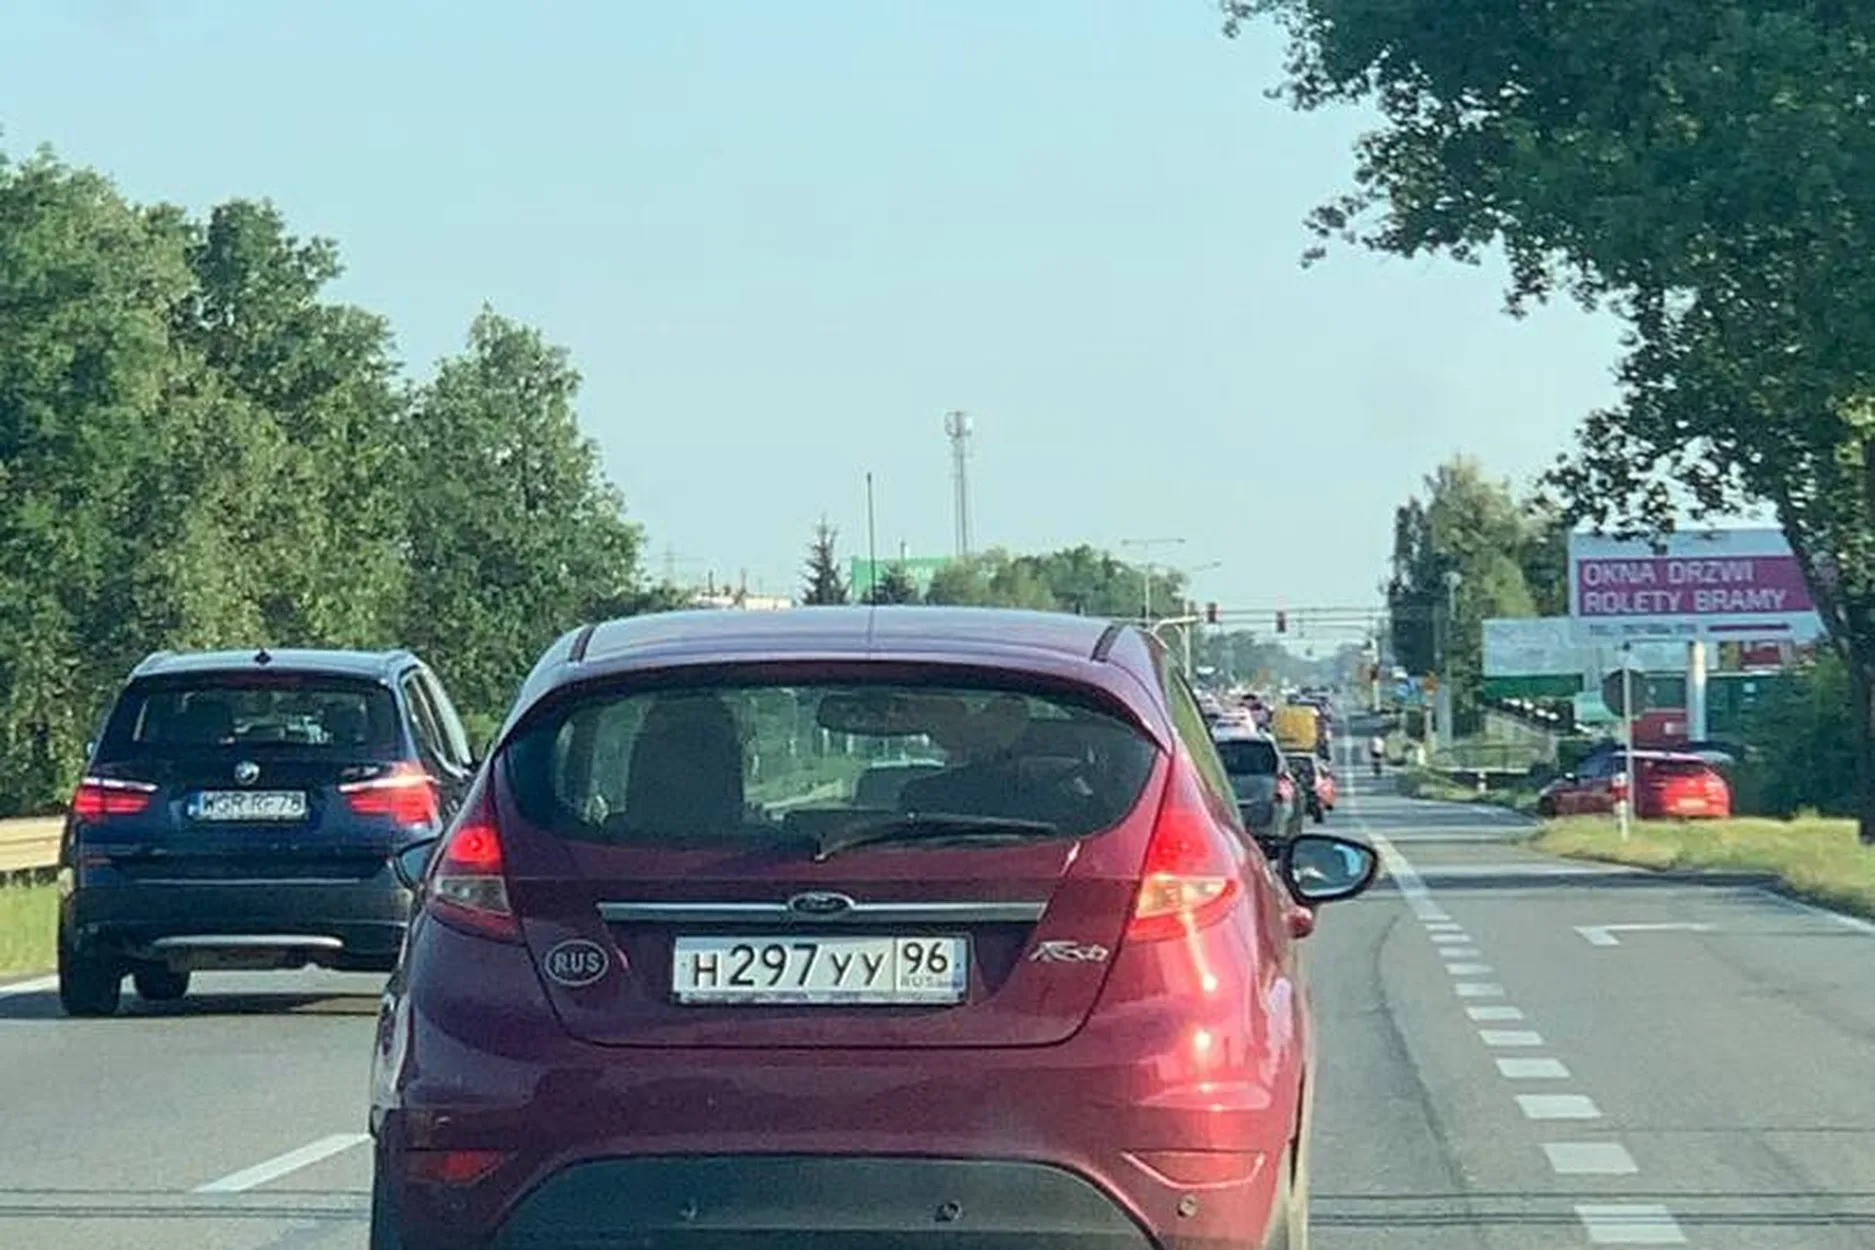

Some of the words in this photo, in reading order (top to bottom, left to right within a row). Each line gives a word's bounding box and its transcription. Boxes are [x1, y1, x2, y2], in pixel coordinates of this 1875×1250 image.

[1584, 562, 1656, 586] OKNA
[1668, 560, 1754, 584] DRZWI
[1584, 590, 1681, 613] ROLETY
[1693, 588, 1787, 612] BRAMY
[554, 951, 600, 974] RUS
[903, 941, 948, 974] 96
